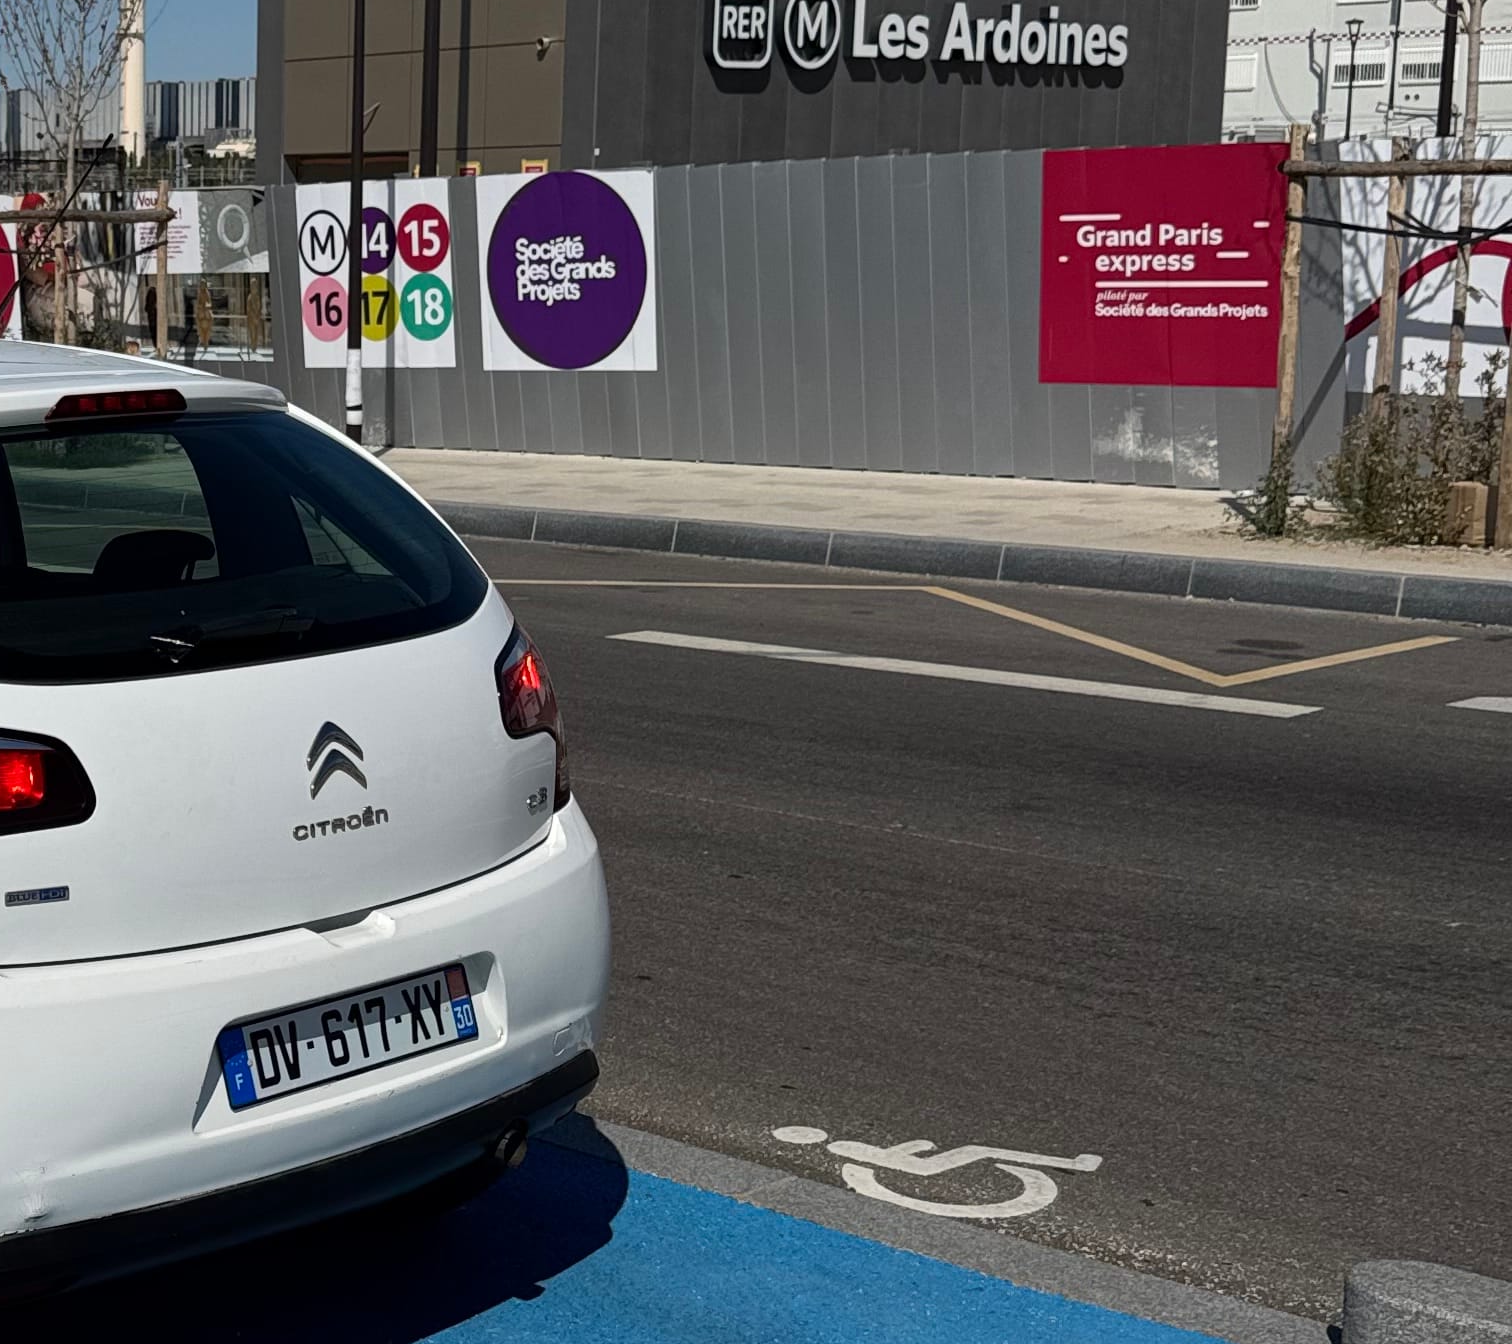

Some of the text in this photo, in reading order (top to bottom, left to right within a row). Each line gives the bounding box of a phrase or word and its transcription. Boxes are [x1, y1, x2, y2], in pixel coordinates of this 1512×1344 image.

[722, 6, 766, 40] RER
[796, 0, 829, 49] M
[940, 2, 1129, 67] Ardoines
[137, 193, 159, 207] Vou
[309, 225, 336, 262] M
[403, 219, 441, 257] 15
[515, 236, 584, 260] Société
[1076, 222, 1224, 248] Grand Paris
[516, 254, 616, 281] des Grands
[1095, 253, 1196, 277] express
[517, 278, 581, 307] Projets
[1128, 292, 1149, 303] par
[309, 288, 445, 327] 16 17 18
[1095, 301, 1269, 320] Société des Grands Projets
[292, 806, 389, 842] CITROËN
[235, 980, 474, 1090] F DV-617-XY 30
